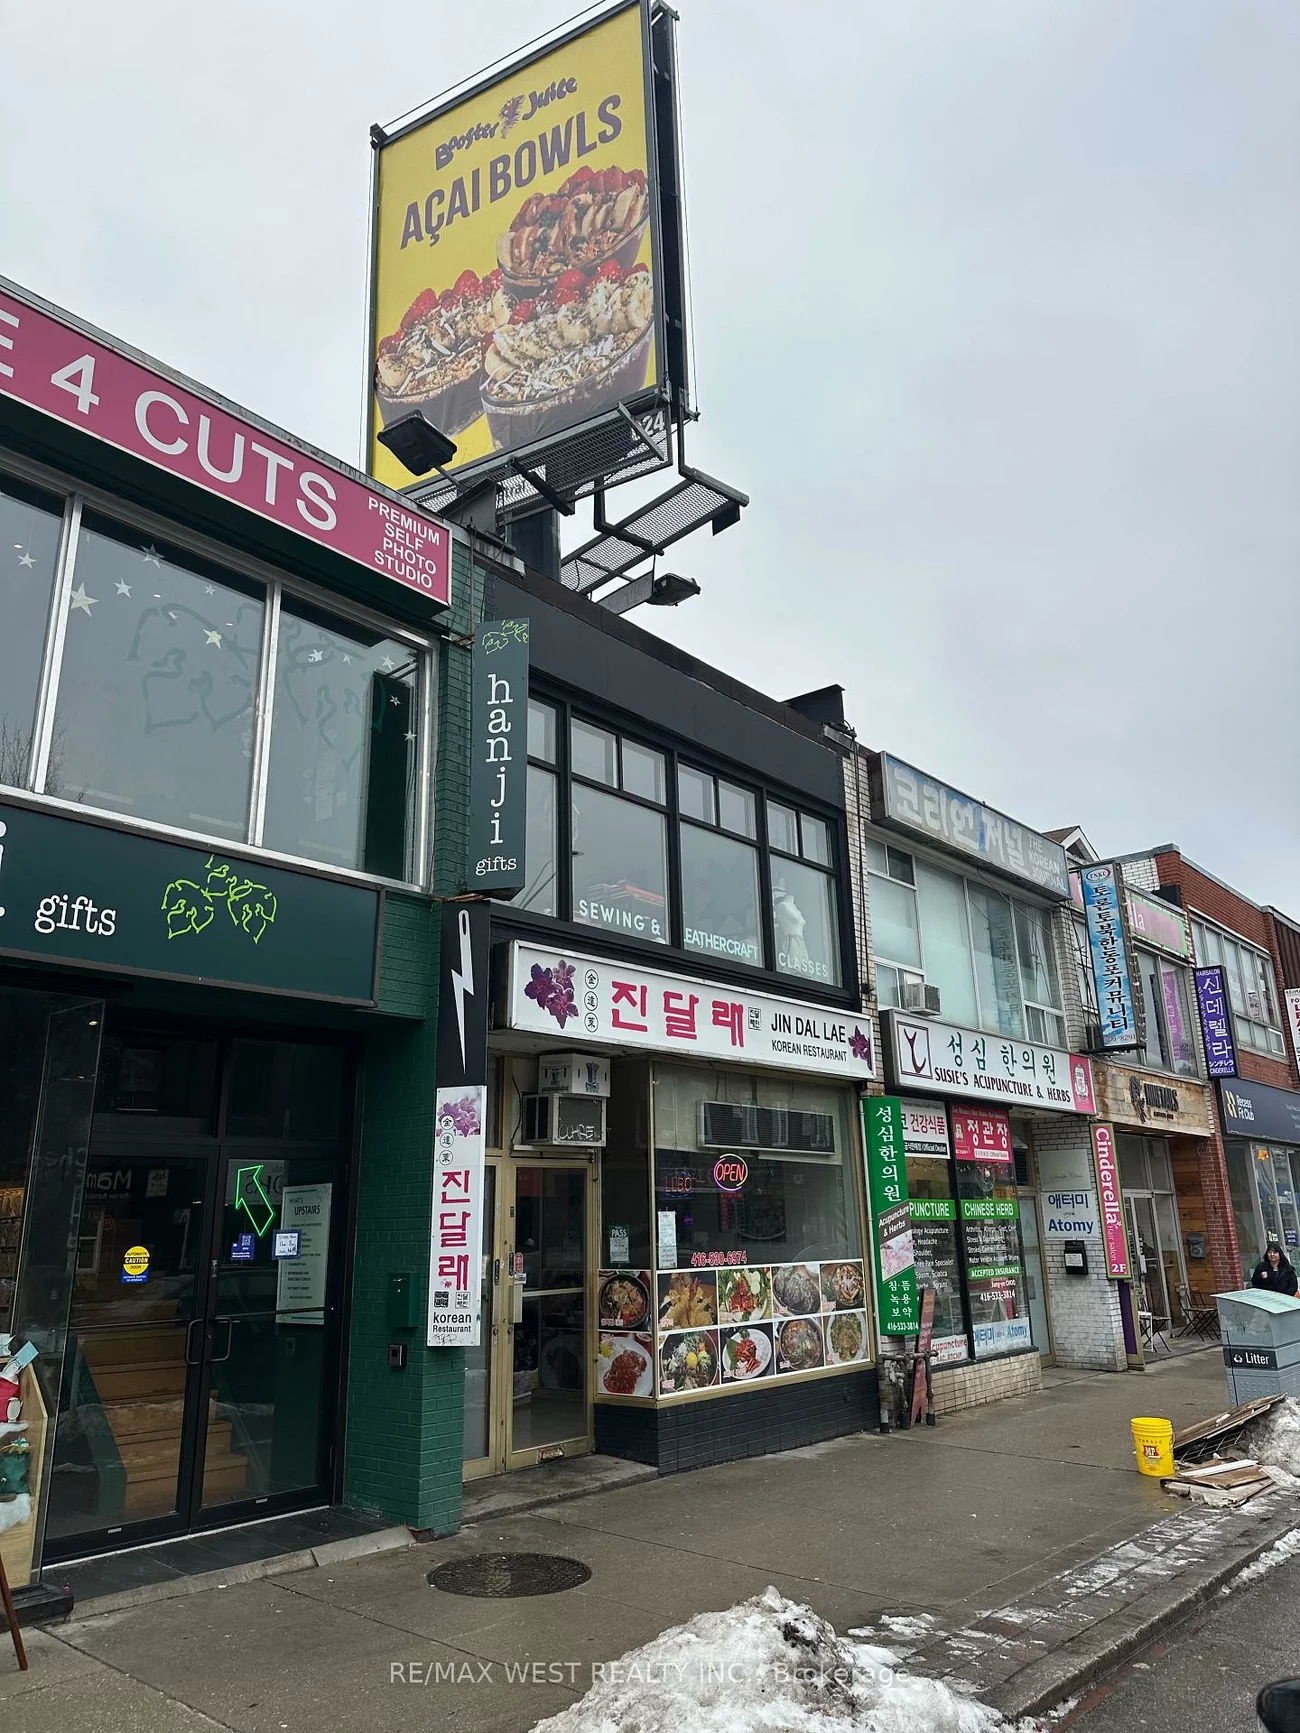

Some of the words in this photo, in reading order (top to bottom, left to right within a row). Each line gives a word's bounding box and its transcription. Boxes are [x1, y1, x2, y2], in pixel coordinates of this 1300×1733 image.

[435, 120, 500, 171] Booster
[523, 77, 578, 120] Juice
[400, 166, 481, 249] AÇAI
[489, 94, 622, 203] BOWLS
[50, 354, 101, 415] 4
[134, 390, 338, 531] CUTS
[368, 496, 440, 546] PREMIUM
[385, 522, 424, 551] SELF
[382, 537, 437, 576] PHOTO
[374, 550, 433, 590] STUDIO
[485, 673, 513, 845] hanji
[475, 856, 517, 876] gifts
[34, 895, 117, 937] gifts
[578, 899, 645, 931] SEWING
[651, 918, 661, 936] &
[778, 952, 828, 978] CLASSES
[611, 980, 744, 1048] 진달래
[1203, 975, 1232, 1058] 신데렐라
[771, 1013, 792, 1034] JIN
[795, 1017, 820, 1039] DAL
[824, 1022, 846, 1044] LAE
[772, 1039, 802, 1056] KOREAN
[803, 1045, 847, 1062] RESTAURANT
[946, 1031, 986, 1071] 성심
[1000, 1043, 1056, 1085] 한의원
[934, 1066, 969, 1086] SUSIE'S
[973, 1073, 1033, 1097] ACUPUNCTURE
[1036, 1085, 1044, 1098] &
[1047, 1087, 1071, 1103] HERBS
[910, 1113, 945, 1135] 건강식품
[967, 1119, 1008, 1149] 정관장
[716, 1163, 744, 1181] OPEN
[1096, 1127, 1119, 1224] Cinderella
[294, 1205, 320, 1216] UPSTAIRS
[909, 1202, 950, 1217] PUNCTURE
[964, 1203, 994, 1216] CHINESE
[996, 1203, 1014, 1216] HERB
[1048, 1193, 1089, 1209] 애터미
[879, 1205, 909, 1228] Acupuncture
[1049, 1219, 1093, 1234] Atomy
[438, 1169, 471, 1291] 진달래
[611, 1229, 627, 1237] PASS
[884, 1228, 888, 1237] &
[888, 1220, 906, 1234] Herbs
[1109, 1242, 1117, 1261] salon
[971, 1268, 994, 1278] ACCEPTED
[994, 1266, 1020, 1276] INSURANCE
[980, 1289, 1016, 1302] 416-533-3814
[432, 1324, 472, 1333] Restaurant
[887, 1322, 919, 1331] 416-533-3814
[1006, 1324, 1026, 1338] Atomy
[932, 1338, 968, 1352] cupuncture
[1246, 1352, 1270, 1364] Litter
